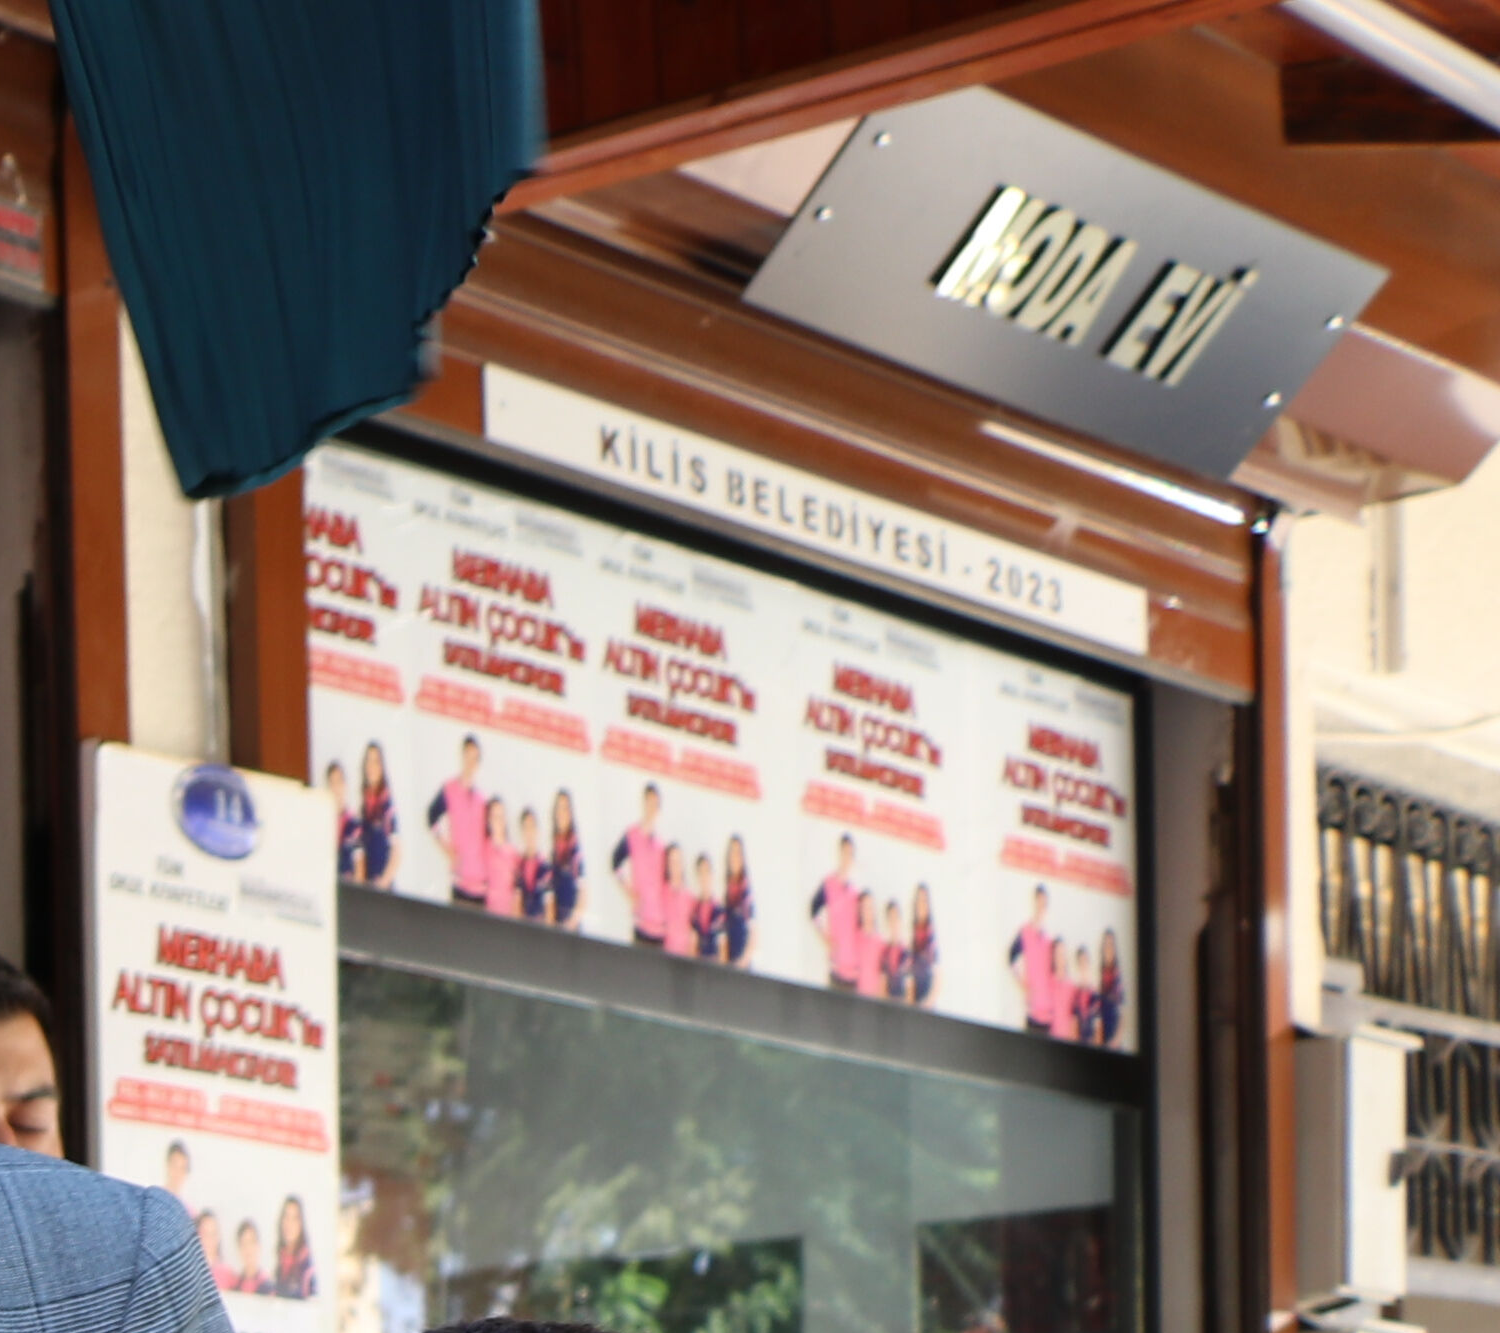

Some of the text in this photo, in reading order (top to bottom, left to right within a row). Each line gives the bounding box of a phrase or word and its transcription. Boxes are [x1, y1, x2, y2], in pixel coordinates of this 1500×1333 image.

[928, 182, 1260, 387] MODA EVİ
[598, 424, 708, 495] KİLİS
[727, 468, 948, 576] BELEDİYESİ
[986, 558, 1065, 614] 2023
[418, 583, 480, 631] ALTIN
[452, 547, 553, 608] MERHABA
[157, 923, 285, 989] MERHABA
[112, 970, 192, 1023] ALTIN
[144, 1031, 298, 1089] SATILMAKTADIR
